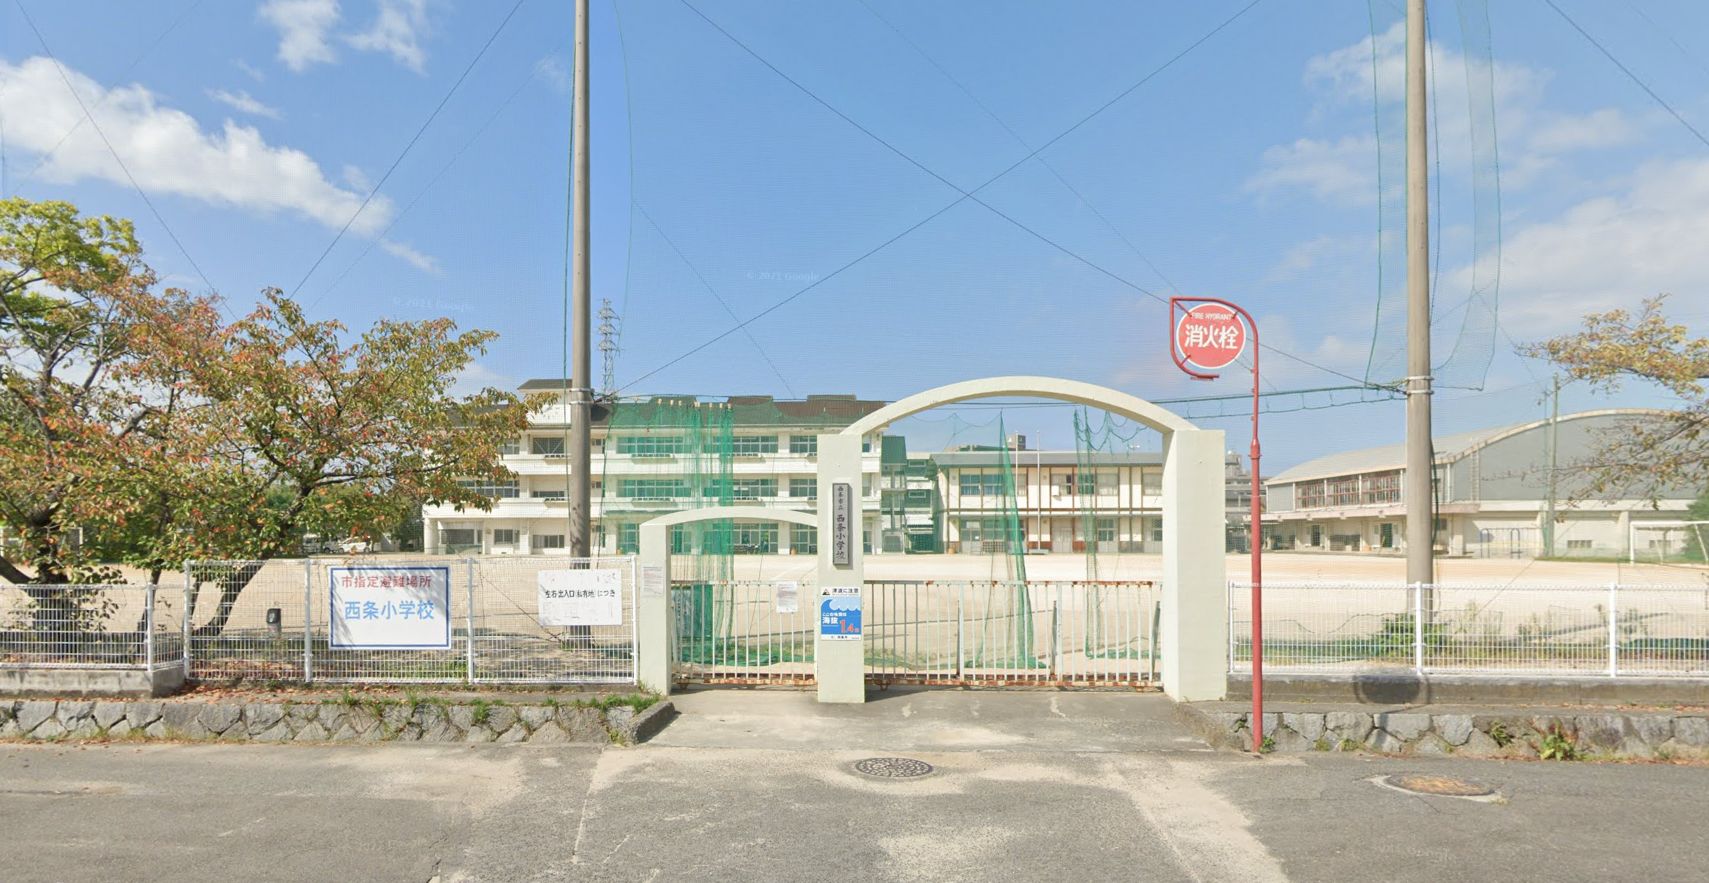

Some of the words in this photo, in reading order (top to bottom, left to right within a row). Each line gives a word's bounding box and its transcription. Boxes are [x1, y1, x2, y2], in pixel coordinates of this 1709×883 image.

[1185, 324, 1239, 349] 消火栓
[836, 514, 846, 560] 西条小学校
[341, 575, 432, 588] 市指定避難場所
[344, 600, 434, 620] 西条小学校
